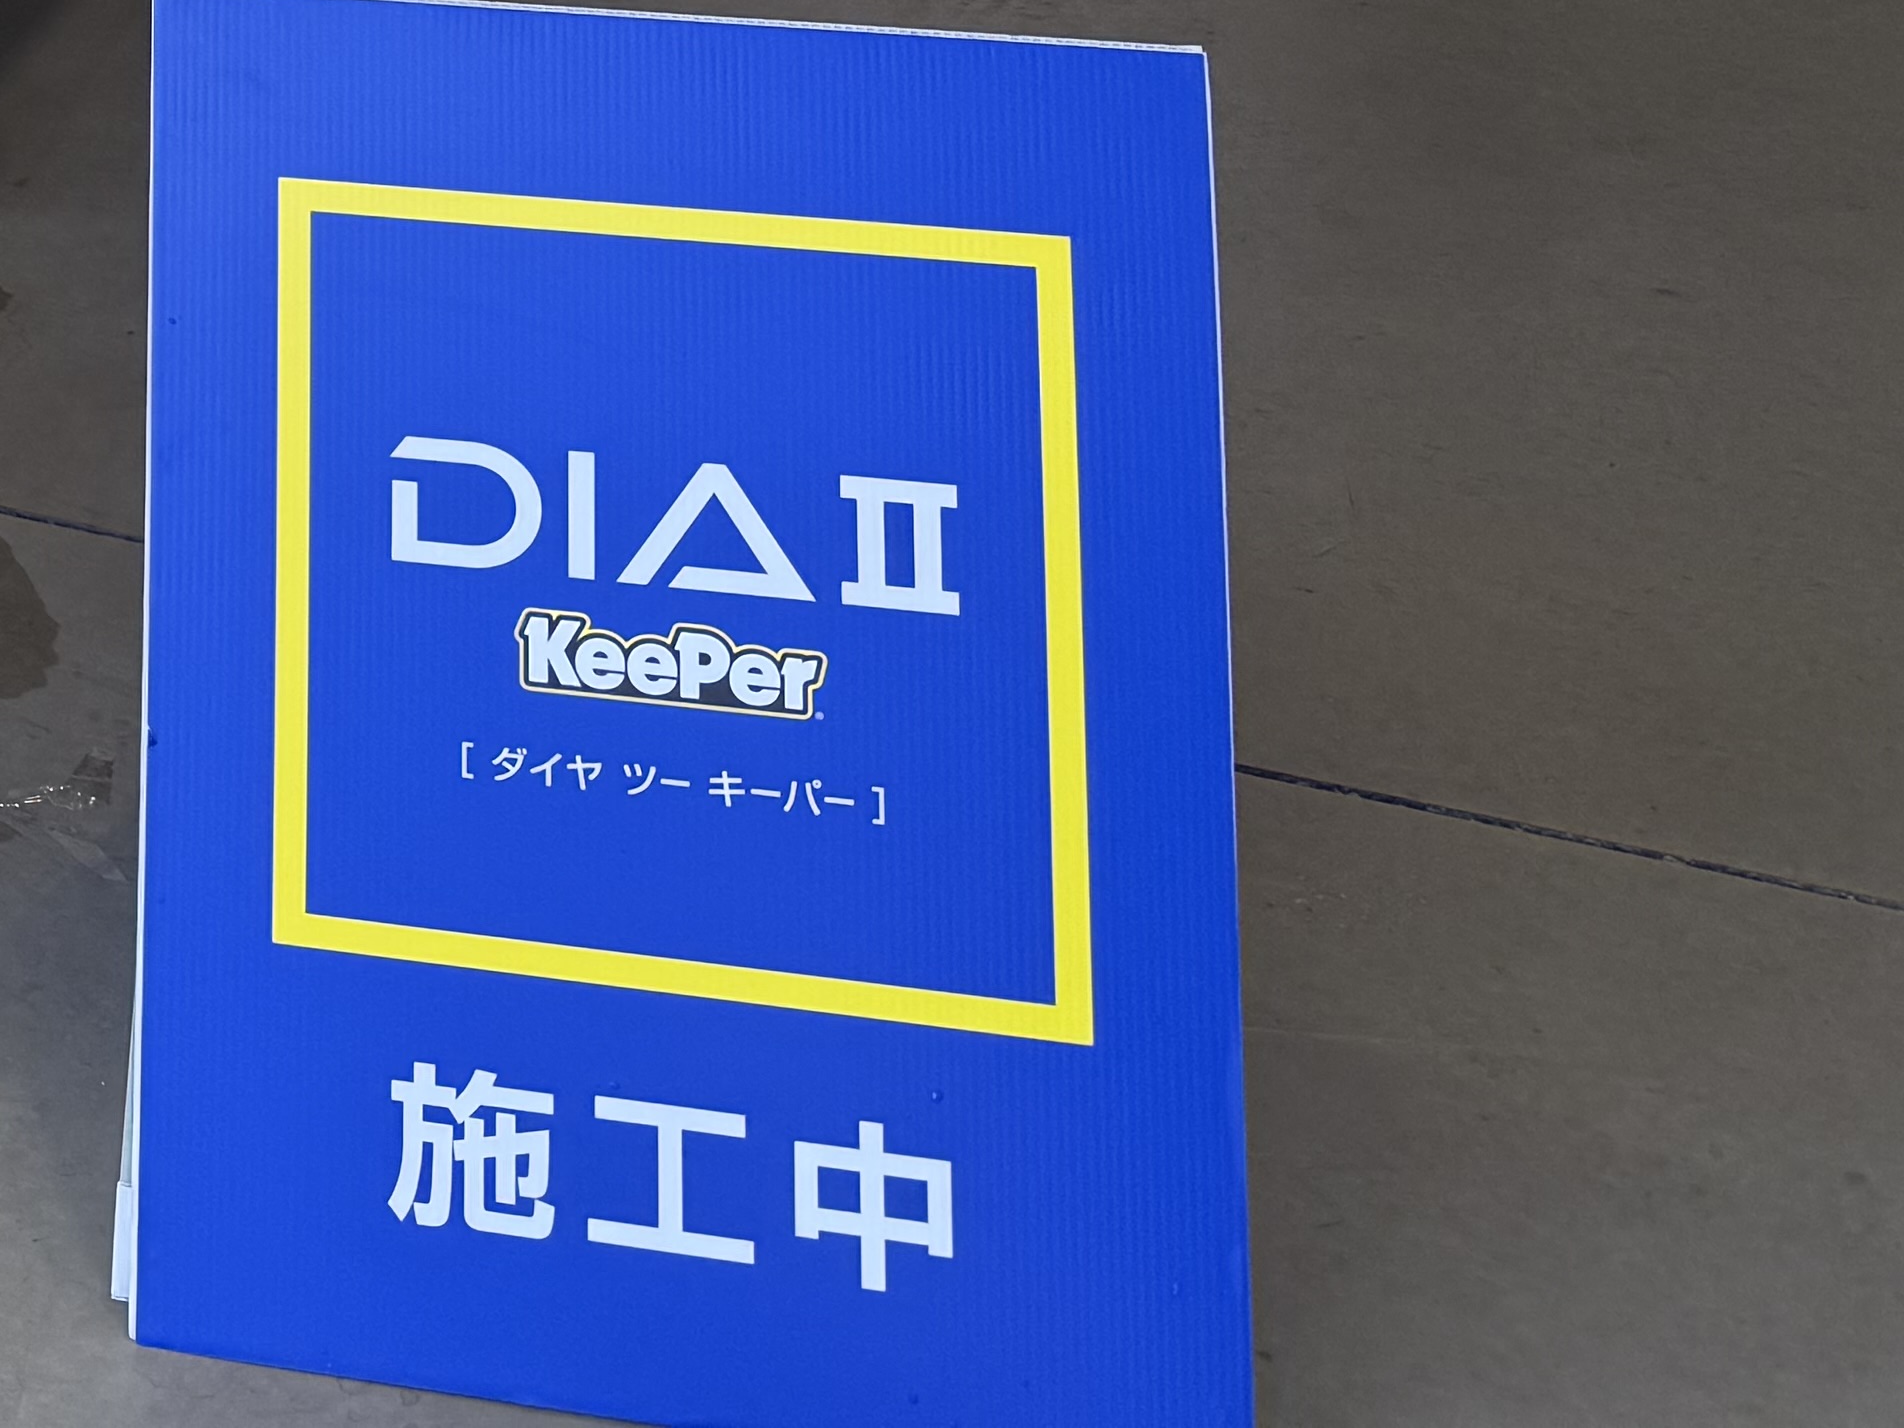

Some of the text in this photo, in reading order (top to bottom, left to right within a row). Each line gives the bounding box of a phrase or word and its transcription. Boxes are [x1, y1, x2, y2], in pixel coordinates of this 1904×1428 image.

[390, 435, 816, 603] DIA
[520, 610, 821, 714] KeePer
[387, 1061, 954, 1293] 施工中
